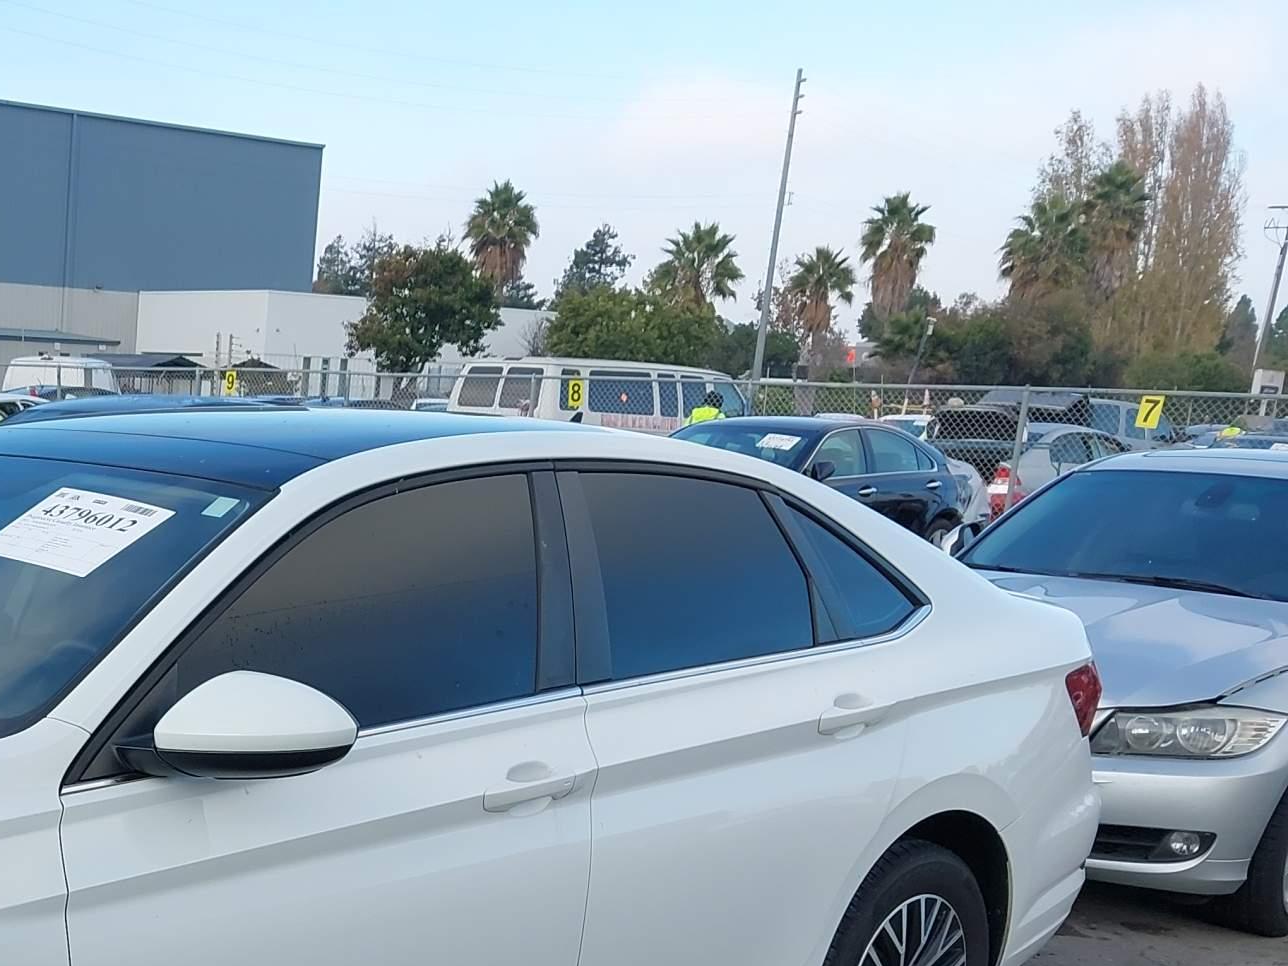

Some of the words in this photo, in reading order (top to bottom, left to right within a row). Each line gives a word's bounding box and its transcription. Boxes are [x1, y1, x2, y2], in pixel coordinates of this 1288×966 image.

[226, 373, 235, 390] 9
[571, 382, 581, 403] 8
[1142, 399, 1161, 423] 7
[41, 503, 138, 532] 43796012
